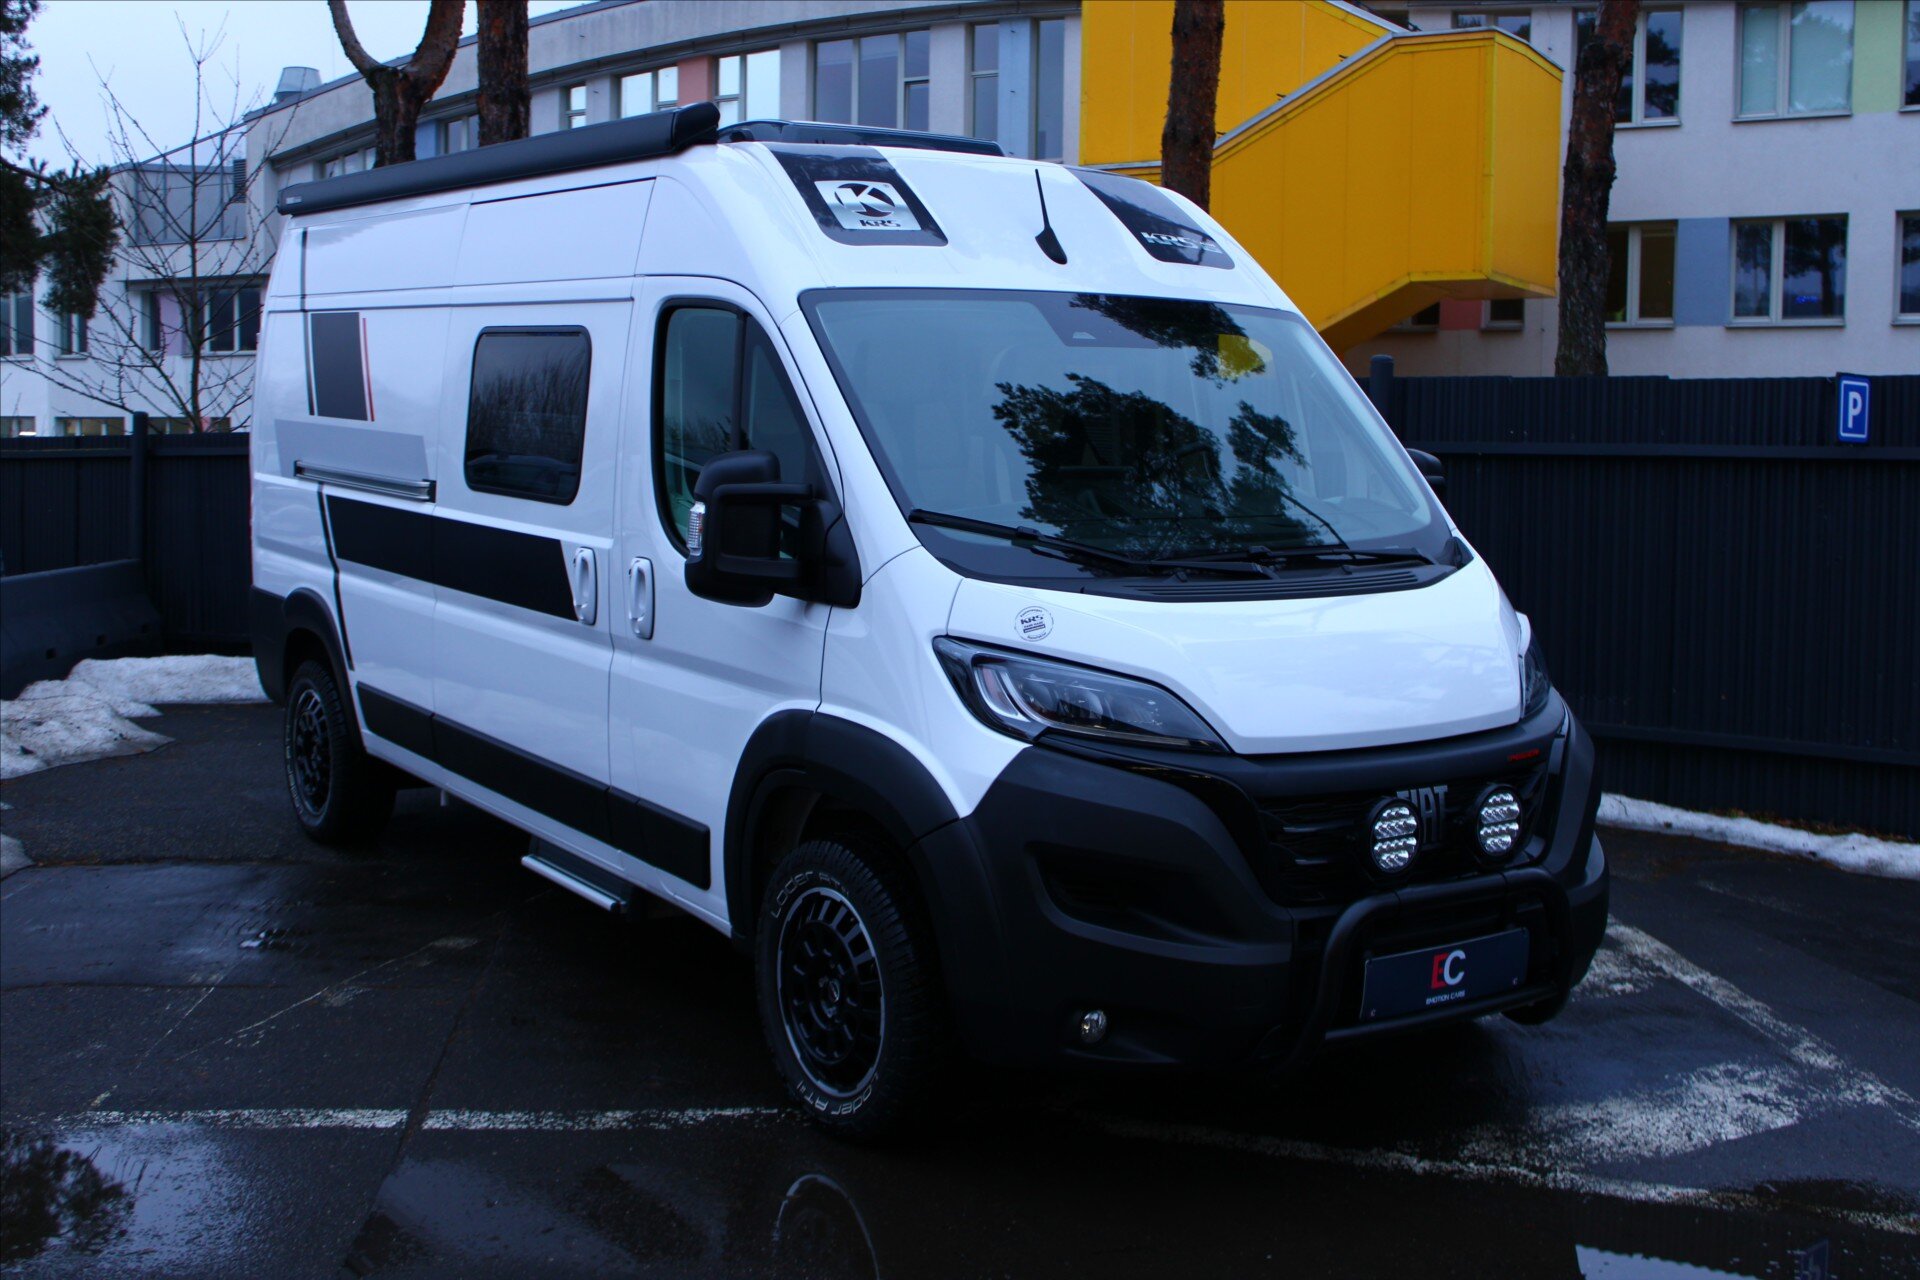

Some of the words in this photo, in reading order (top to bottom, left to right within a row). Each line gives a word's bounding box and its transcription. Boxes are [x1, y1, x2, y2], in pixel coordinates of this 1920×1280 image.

[859, 219, 902, 228] KRS
[1141, 231, 1200, 249] KRS
[1847, 391, 1863, 429] P
[1020, 614, 1044, 625] KRS
[1396, 784, 1449, 845] AT
[1431, 949, 1466, 989] EC
